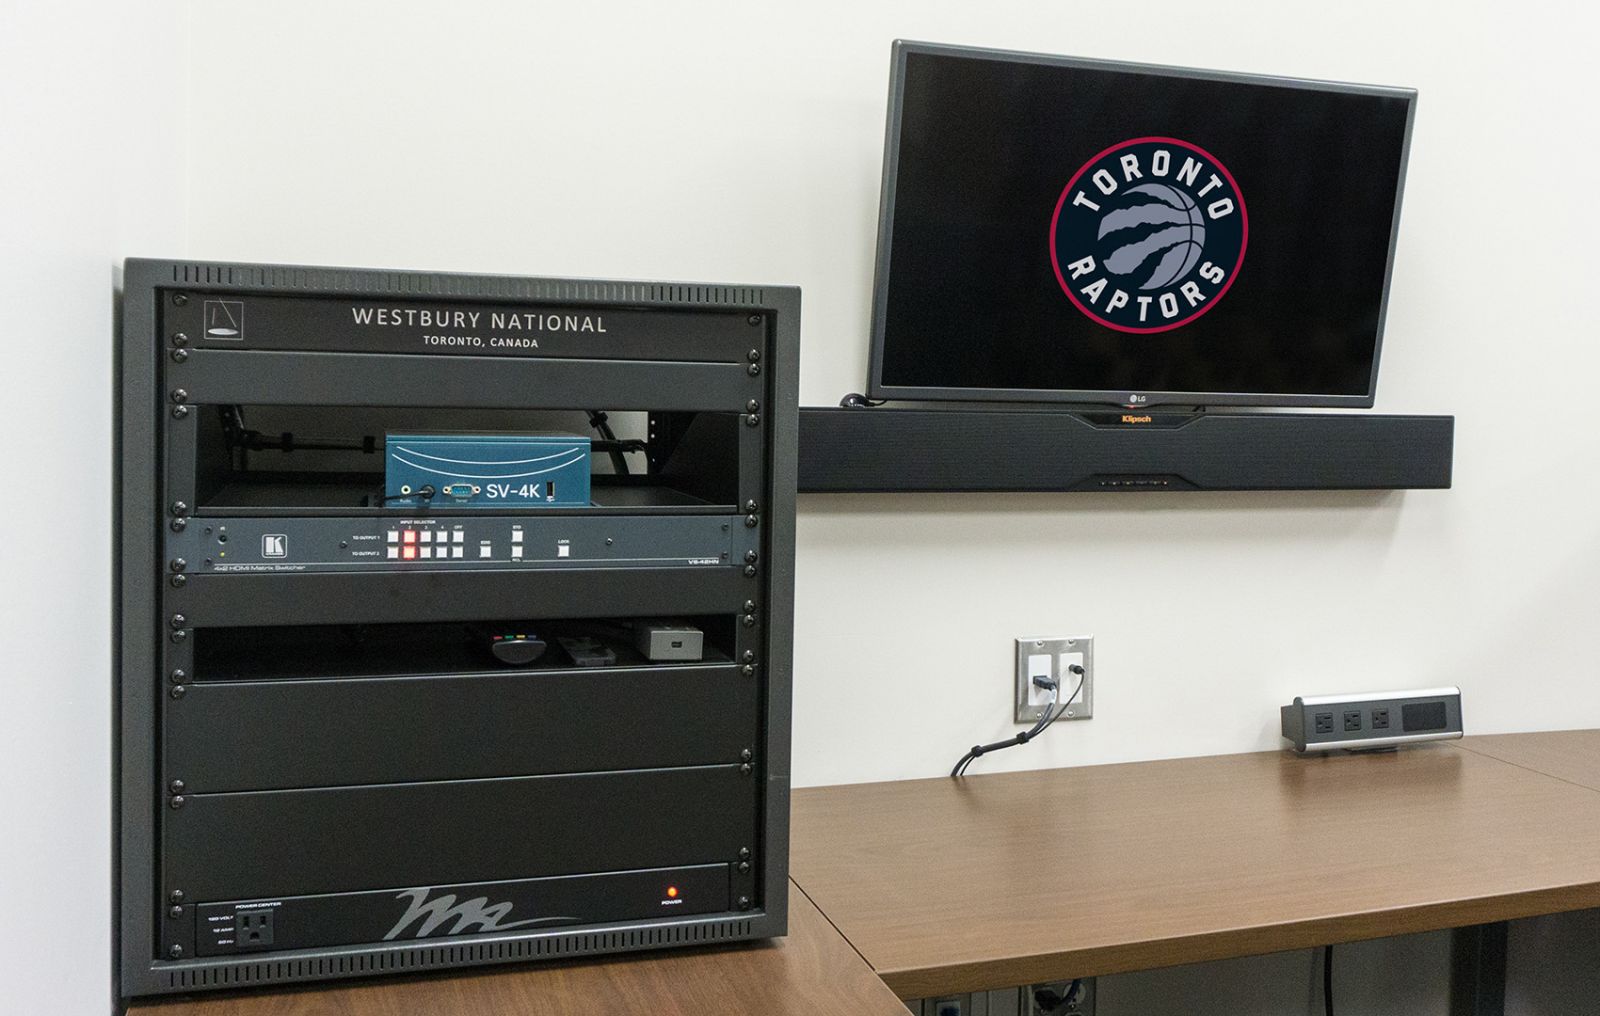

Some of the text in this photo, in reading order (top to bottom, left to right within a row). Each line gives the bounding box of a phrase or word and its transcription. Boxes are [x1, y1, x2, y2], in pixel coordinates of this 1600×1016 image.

[1072, 150, 1235, 220] TORONTO
[1067, 255, 1225, 322] RAPTORS
[352, 307, 607, 333] WESTBURY NATIONAL
[423, 335, 539, 348] TORONTO, CANADA
[1122, 415, 1152, 423] Klipsch
[486, 483, 541, 499] SV-4K
